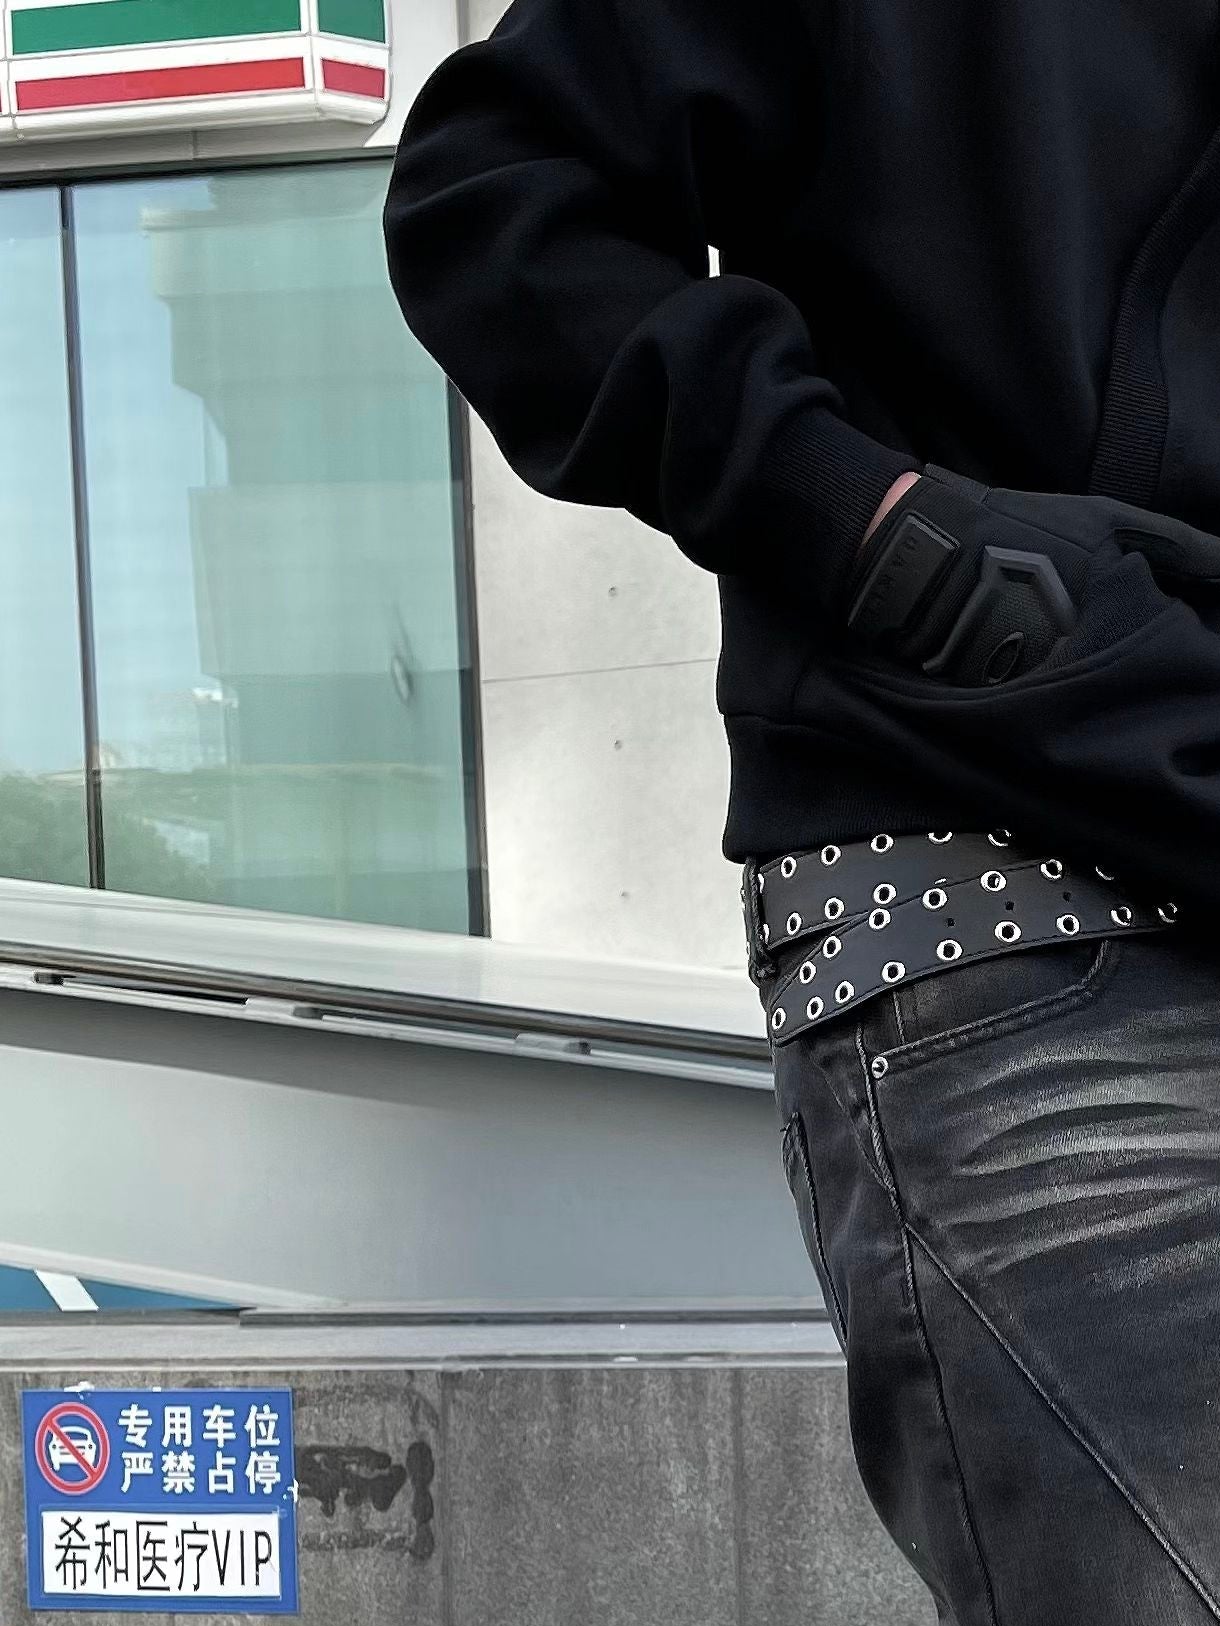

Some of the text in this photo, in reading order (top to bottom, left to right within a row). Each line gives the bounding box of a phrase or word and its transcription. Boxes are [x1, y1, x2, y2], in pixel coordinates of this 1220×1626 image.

[118, 1404, 280, 1448] 专用车位
[121, 1450, 281, 1494] 严禁占停
[55, 1516, 272, 1591] 希和医疗VIP
